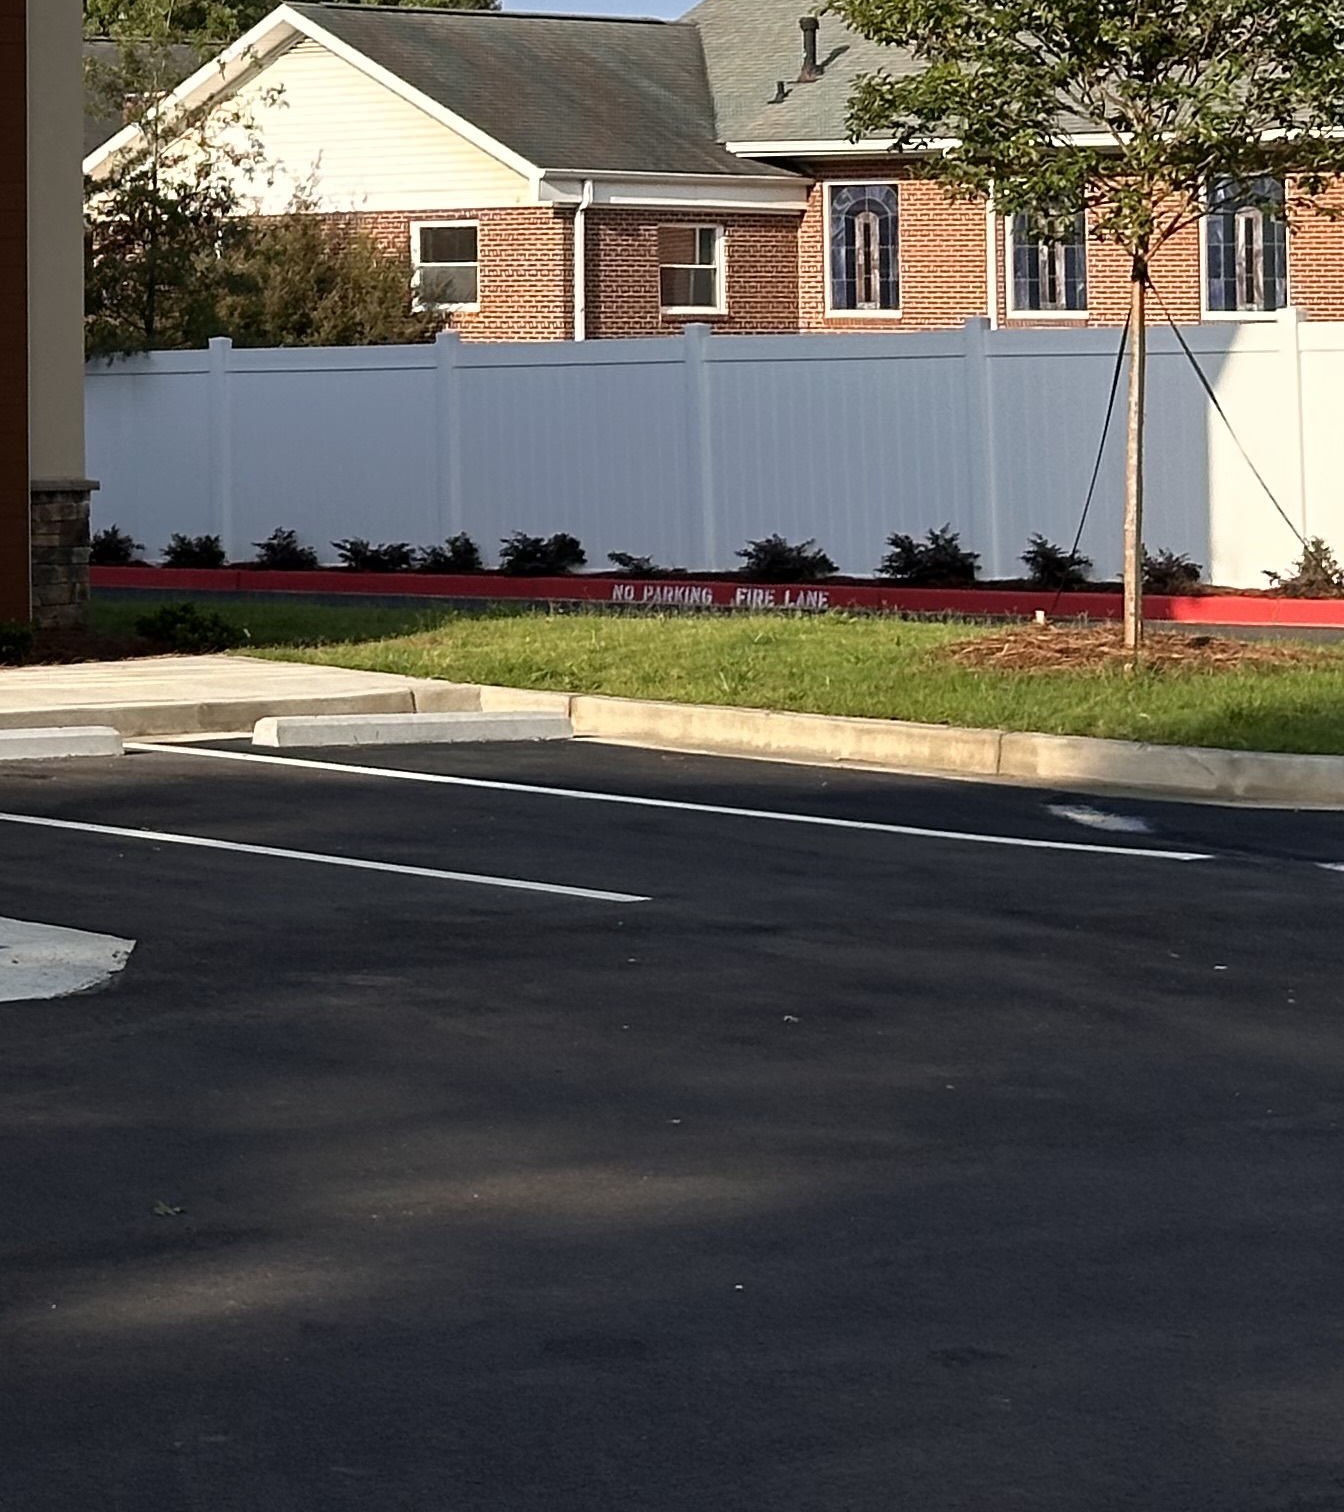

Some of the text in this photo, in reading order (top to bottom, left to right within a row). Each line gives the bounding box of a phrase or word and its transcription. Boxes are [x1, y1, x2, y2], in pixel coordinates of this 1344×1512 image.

[612, 584, 830, 609] NO PARKING FIRE LANE
